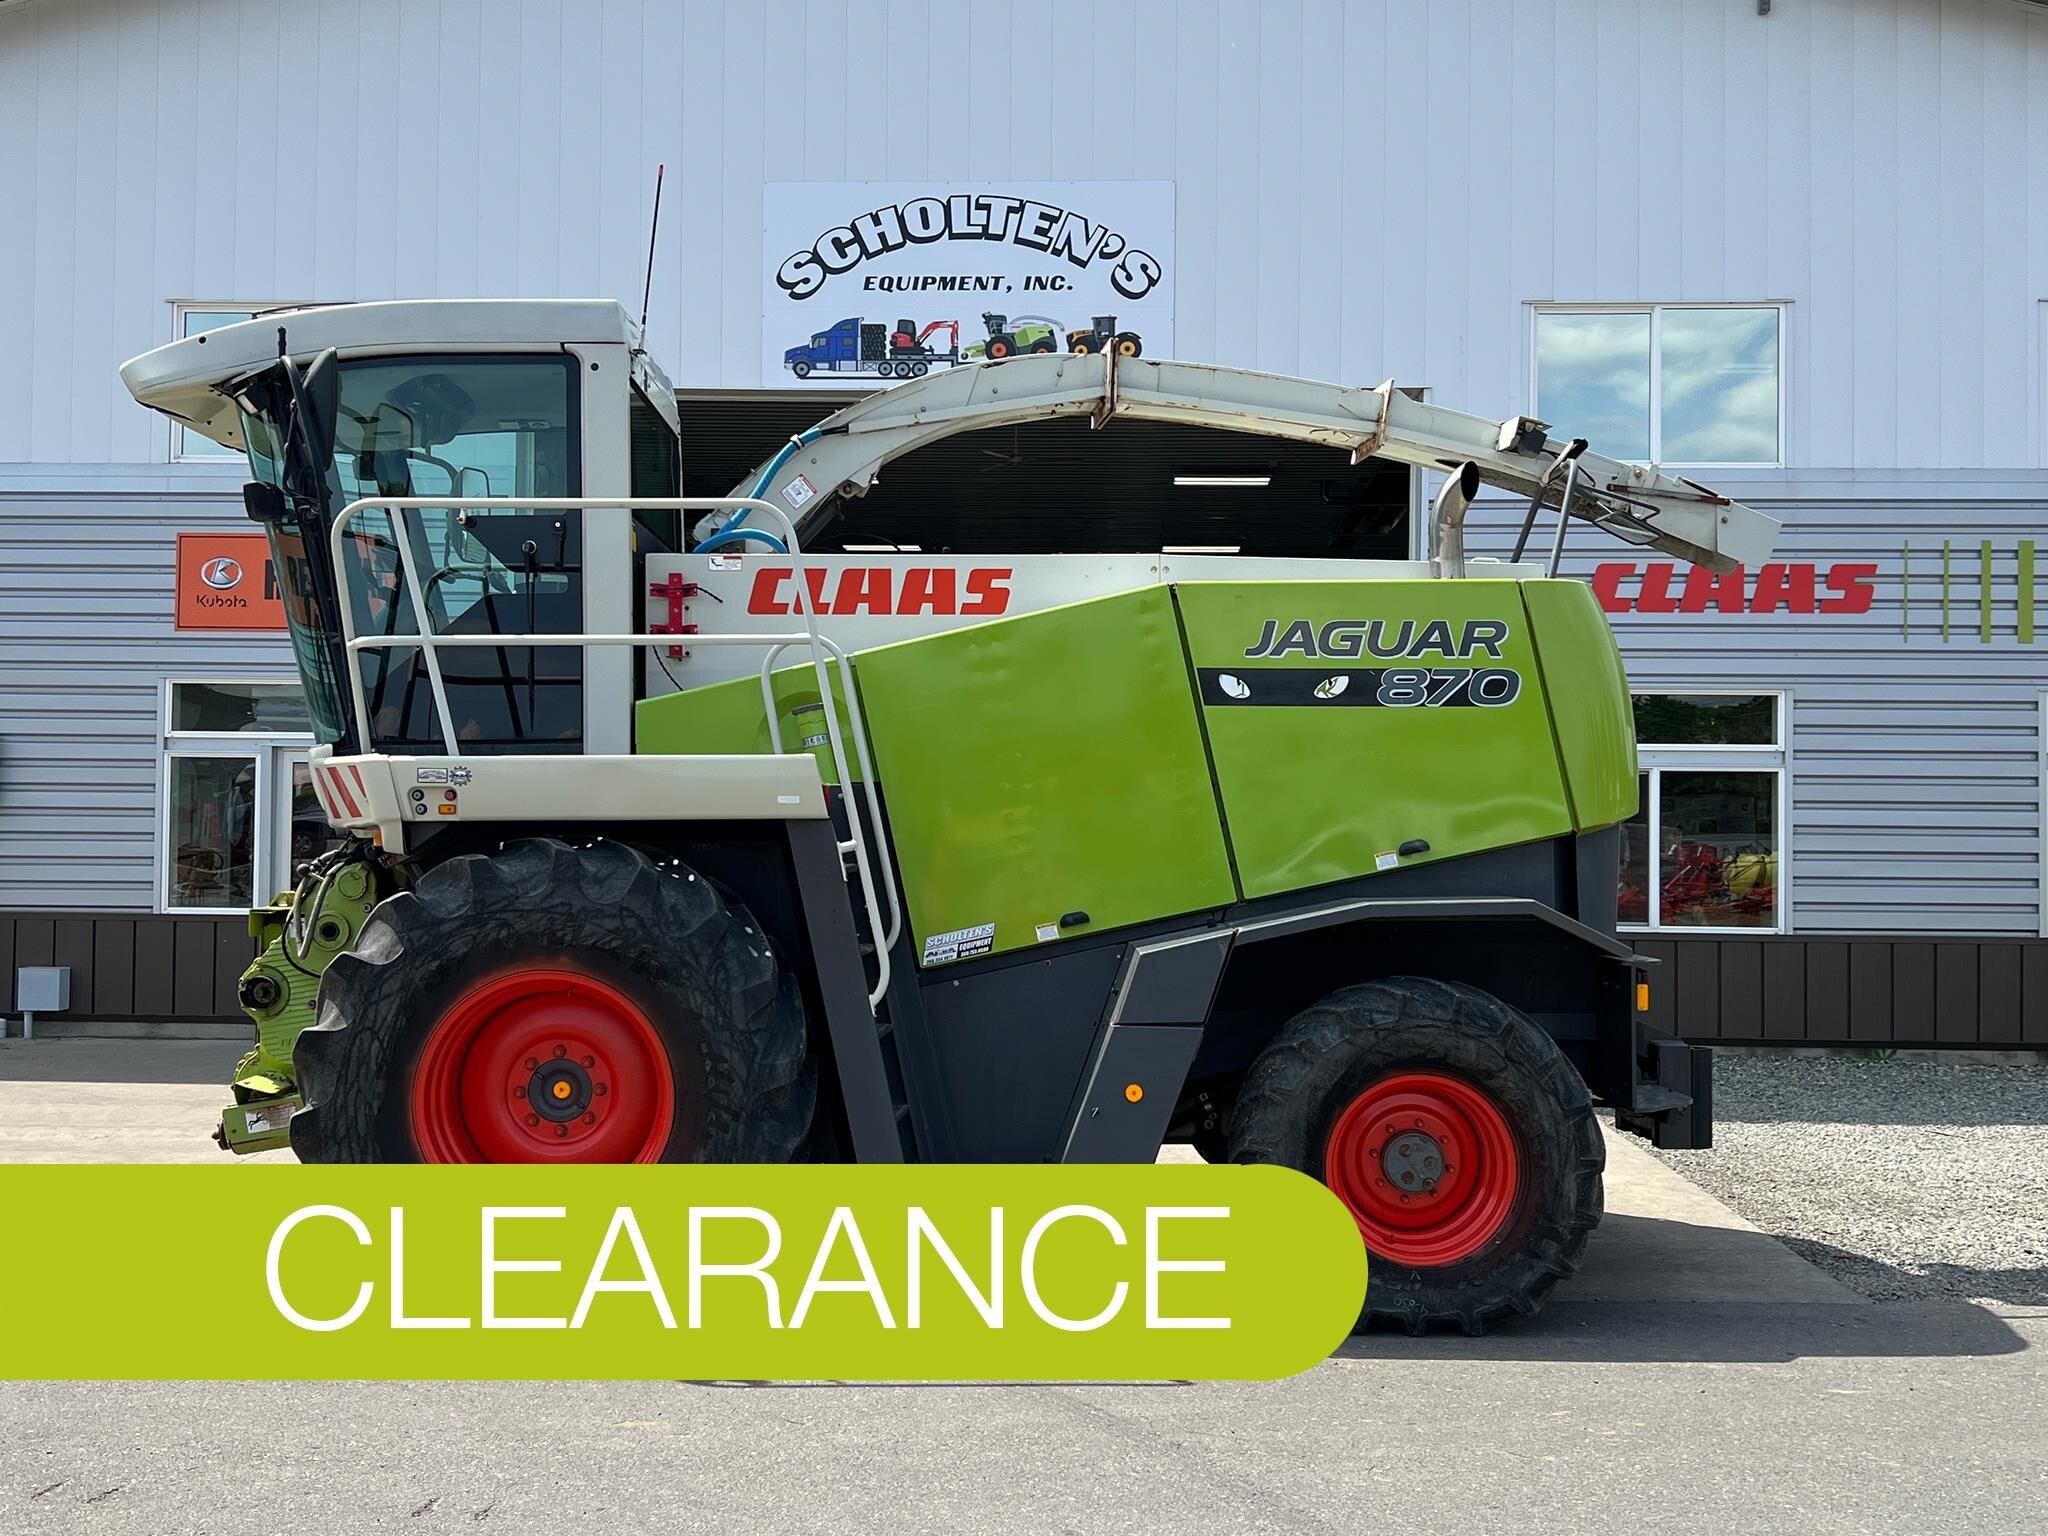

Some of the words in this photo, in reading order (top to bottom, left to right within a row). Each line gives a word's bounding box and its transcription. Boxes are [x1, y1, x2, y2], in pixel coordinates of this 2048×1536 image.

[776, 194, 1162, 300] SCHOLTEN'S
[863, 275, 1013, 293] EQUIPMENT,
[1023, 275, 1074, 291] INC.
[197, 594, 247, 608] Kubota
[747, 568, 1013, 615] CLAAS
[1591, 563, 1878, 613] CLAAS
[1244, 620, 1509, 659] JAGUAR
[1376, 668, 1522, 707] 870
[927, 925, 994, 947] SCHOLTEN'S
